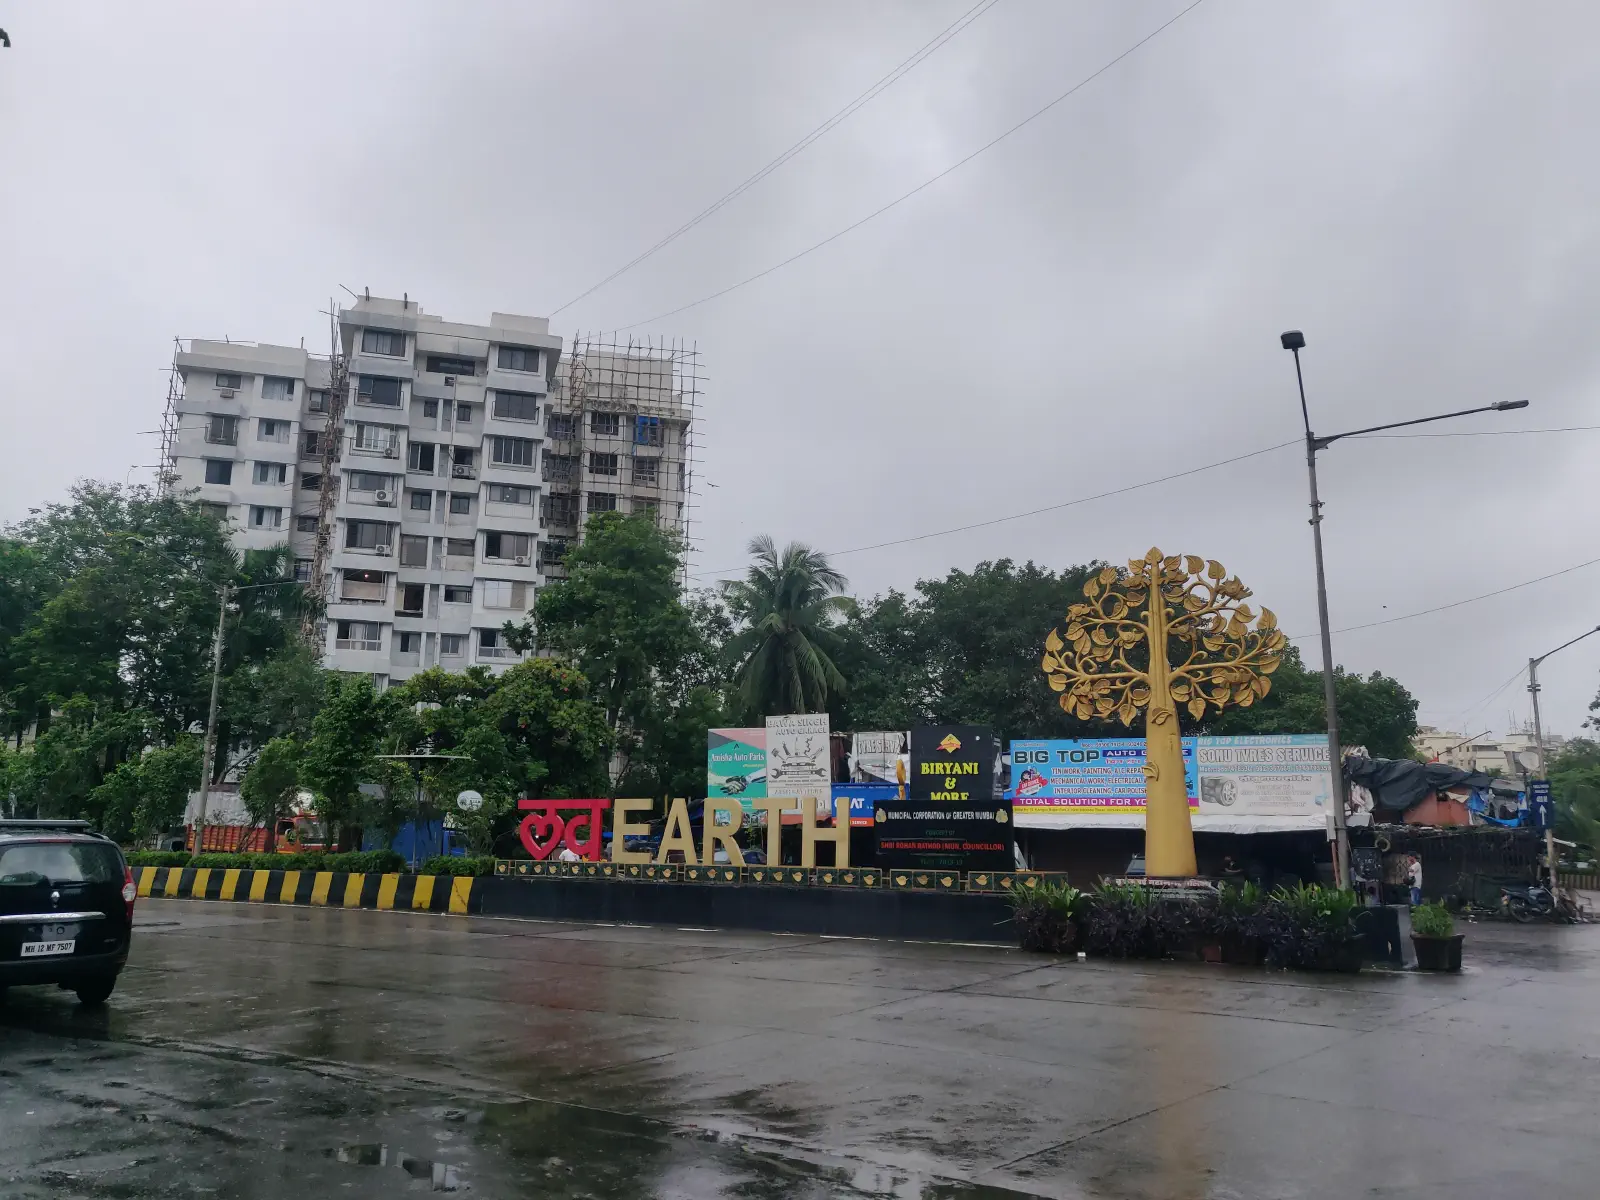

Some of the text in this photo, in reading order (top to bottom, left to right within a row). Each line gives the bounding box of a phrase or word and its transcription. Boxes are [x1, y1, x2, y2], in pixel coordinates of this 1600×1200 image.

[767, 720, 795, 728] BAWA
[775, 728, 796, 736] AUTO
[1234, 736, 1292, 744] ELECTRONICS
[711, 752, 765, 762] Amisha Auto Parts
[1014, 750, 1049, 764] BIG
[1056, 750, 1100, 764] TOP
[1235, 748, 1274, 762] TYRES
[1276, 747, 1331, 762] SERVICE
[920, 762, 979, 775] BIRYANI
[1062, 768, 1082, 776] WORK,
[944, 777, 957, 790] &
[1087, 778, 1106, 786] WORK,
[930, 792, 970, 800] MORE
[834, 796, 865, 810] AT
[888, 811, 995, 820] MUNICIPAL CORPORATION OF GREATER MUMBAI
[517, 797, 850, 868] लव EARTH
[881, 842, 894, 850] SHRI
[896, 842, 916, 850] ROHAN
[917, 842, 941, 850] RATHOD
[962, 843, 1005, 851] COUNCILLOR)
[46, 944, 55, 952] MF
[57, 942, 72, 950] 7507
